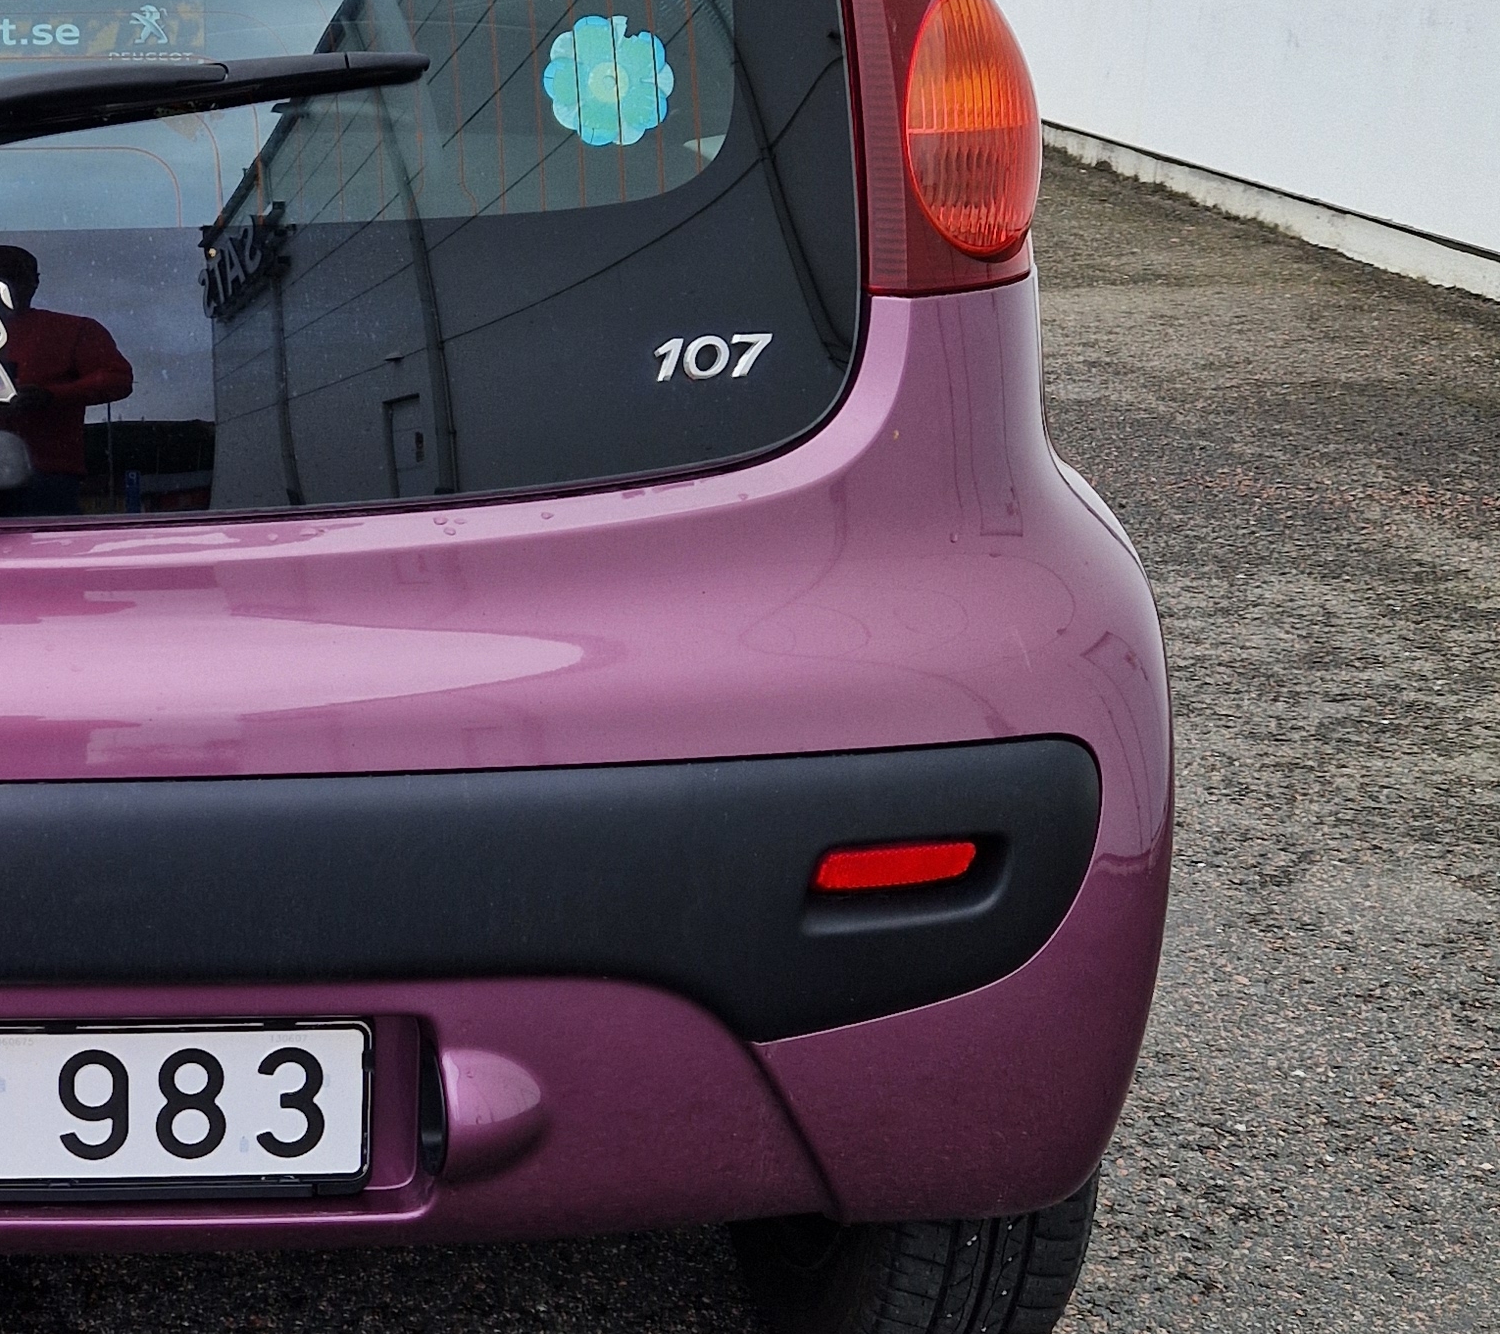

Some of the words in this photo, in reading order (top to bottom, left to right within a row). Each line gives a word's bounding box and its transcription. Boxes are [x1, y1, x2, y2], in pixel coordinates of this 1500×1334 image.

[108, 51, 193, 61] PEUGEOT
[654, 333, 773, 382] 107
[58, 1046, 325, 1161] 983
